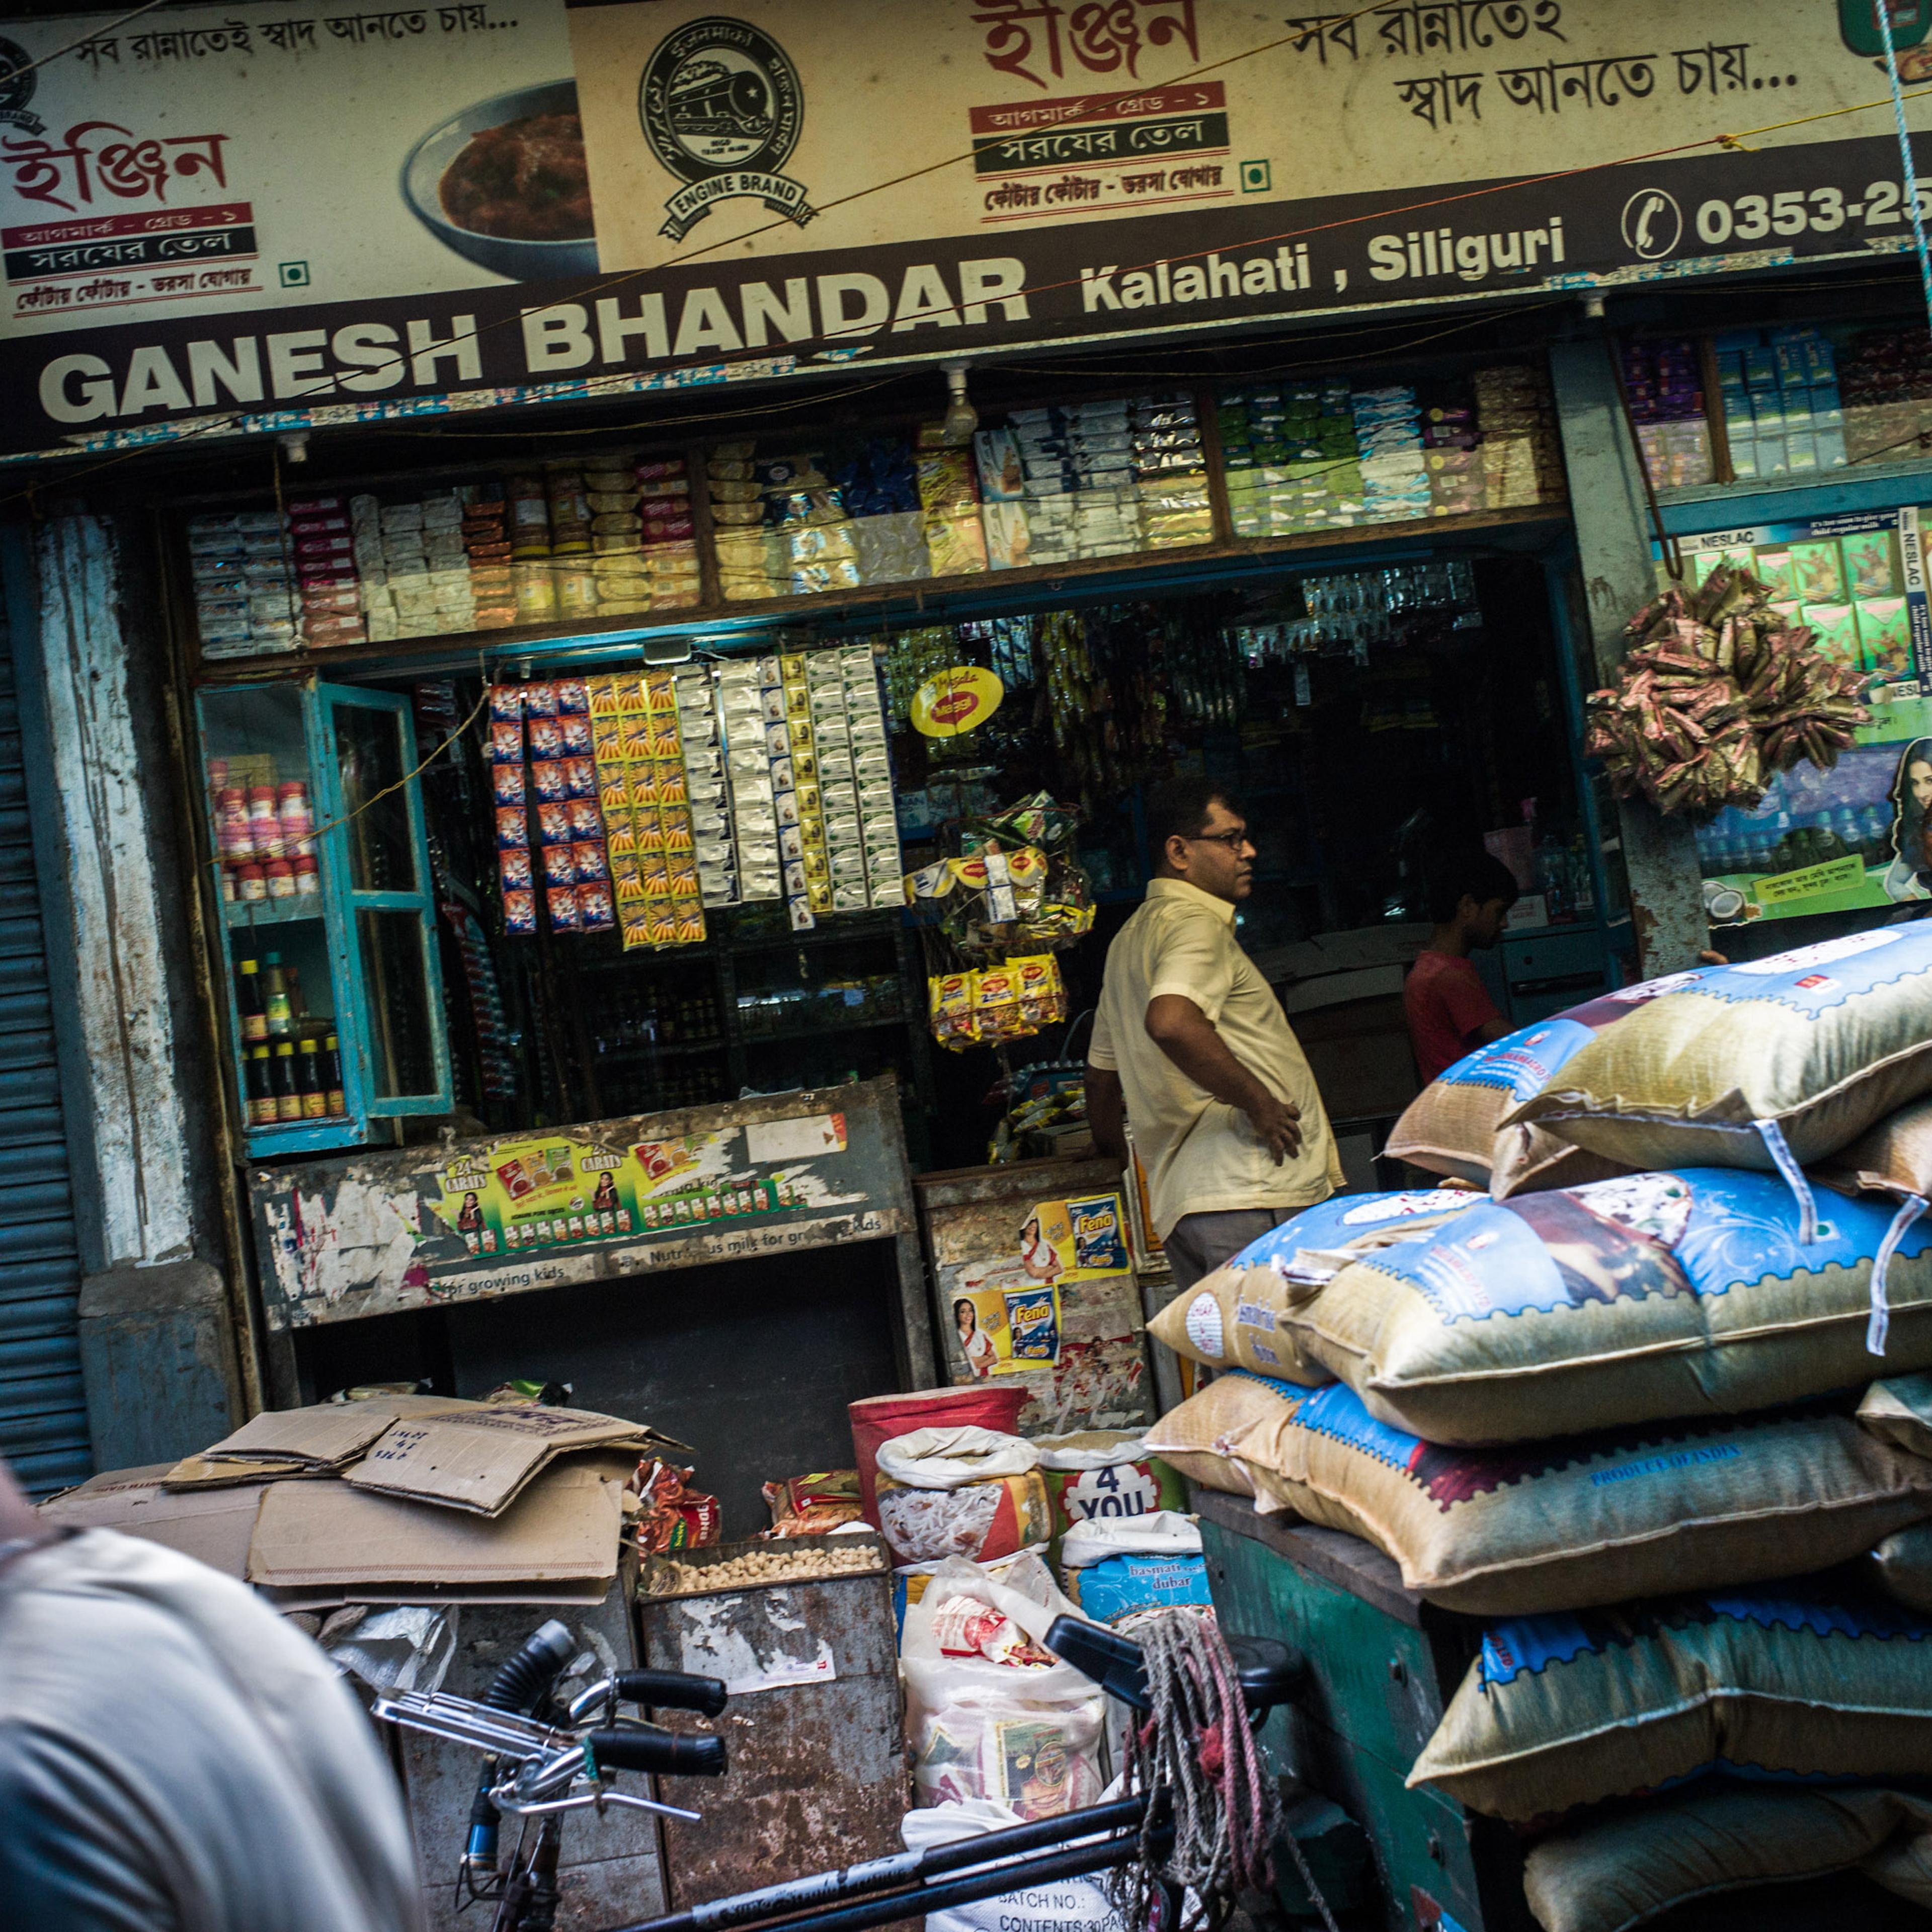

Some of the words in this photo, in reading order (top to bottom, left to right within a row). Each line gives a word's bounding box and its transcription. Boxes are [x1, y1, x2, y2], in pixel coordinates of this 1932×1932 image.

[75, 37, 121, 68] সব
[129, 19, 252, 61] রান্নাতেই
[258, 18, 317, 50] স্বাদ
[323, 10, 428, 43] আনতে
[1285, 14, 1357, 65] সব
[1393, 70, 1484, 129] স্বাদ
[1496, 54, 1659, 113] আনতে
[988, 99, 1088, 127] আগমার্ক
[1115, 96, 1164, 115] গ্রেড
[1130, 120, 1203, 148] তেল
[0, 120, 231, 212] ইঞ্জিন
[674, 175, 734, 215] ENGINE
[740, 174, 797, 202] BRAND
[158, 232, 231, 256] তেল
[38, 314, 482, 424] GANESH
[520, 257, 1031, 373] BHANDAR
[1080, 244, 1311, 312] Kalahati
[1367, 216, 1565, 281] Siliguri
[1702, 531, 1755, 547] NESLAC
[1904, 534, 1920, 585] NESLAC
[456, 1162, 472, 1175] 24
[446, 1174, 487, 1193] CARATS
[1079, 1214, 1112, 1234] Fena
[762, 1234, 784, 1246] for
[468, 1273, 531, 1295] growing
[534, 1265, 565, 1281] kids
[1016, 1304, 1050, 1324] Fena
[1096, 1466, 1120, 1493] 4
[1078, 1490, 1144, 1519] YOU
[1129, 1563, 1181, 1576] basmati
[1152, 1576, 1192, 1589] dubar
